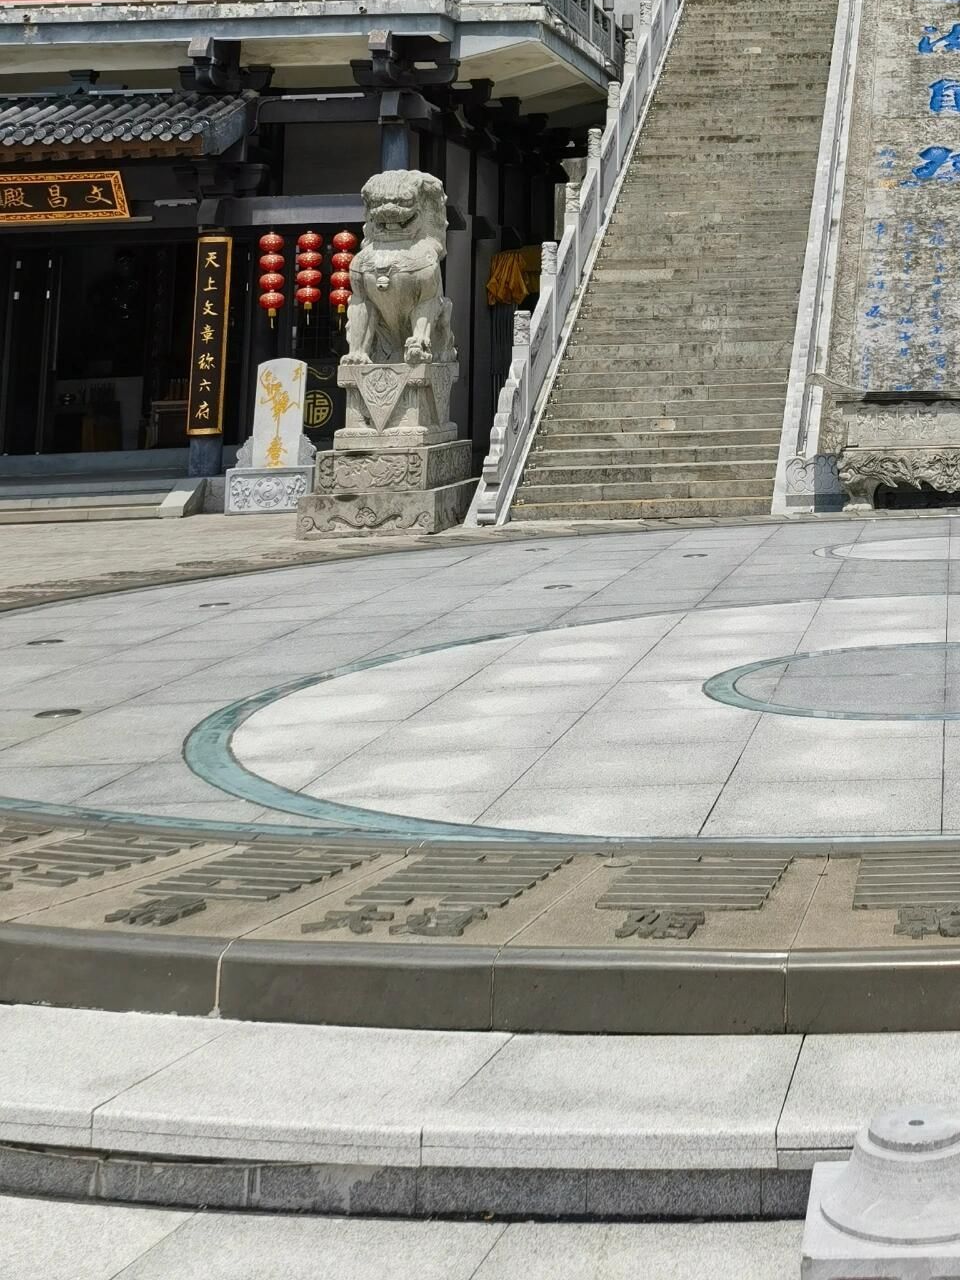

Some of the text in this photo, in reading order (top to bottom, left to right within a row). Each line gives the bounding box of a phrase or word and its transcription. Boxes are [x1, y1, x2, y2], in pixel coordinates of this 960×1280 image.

[4, 183, 113, 208] 文昌殿
[304, 394, 330, 425] 福
